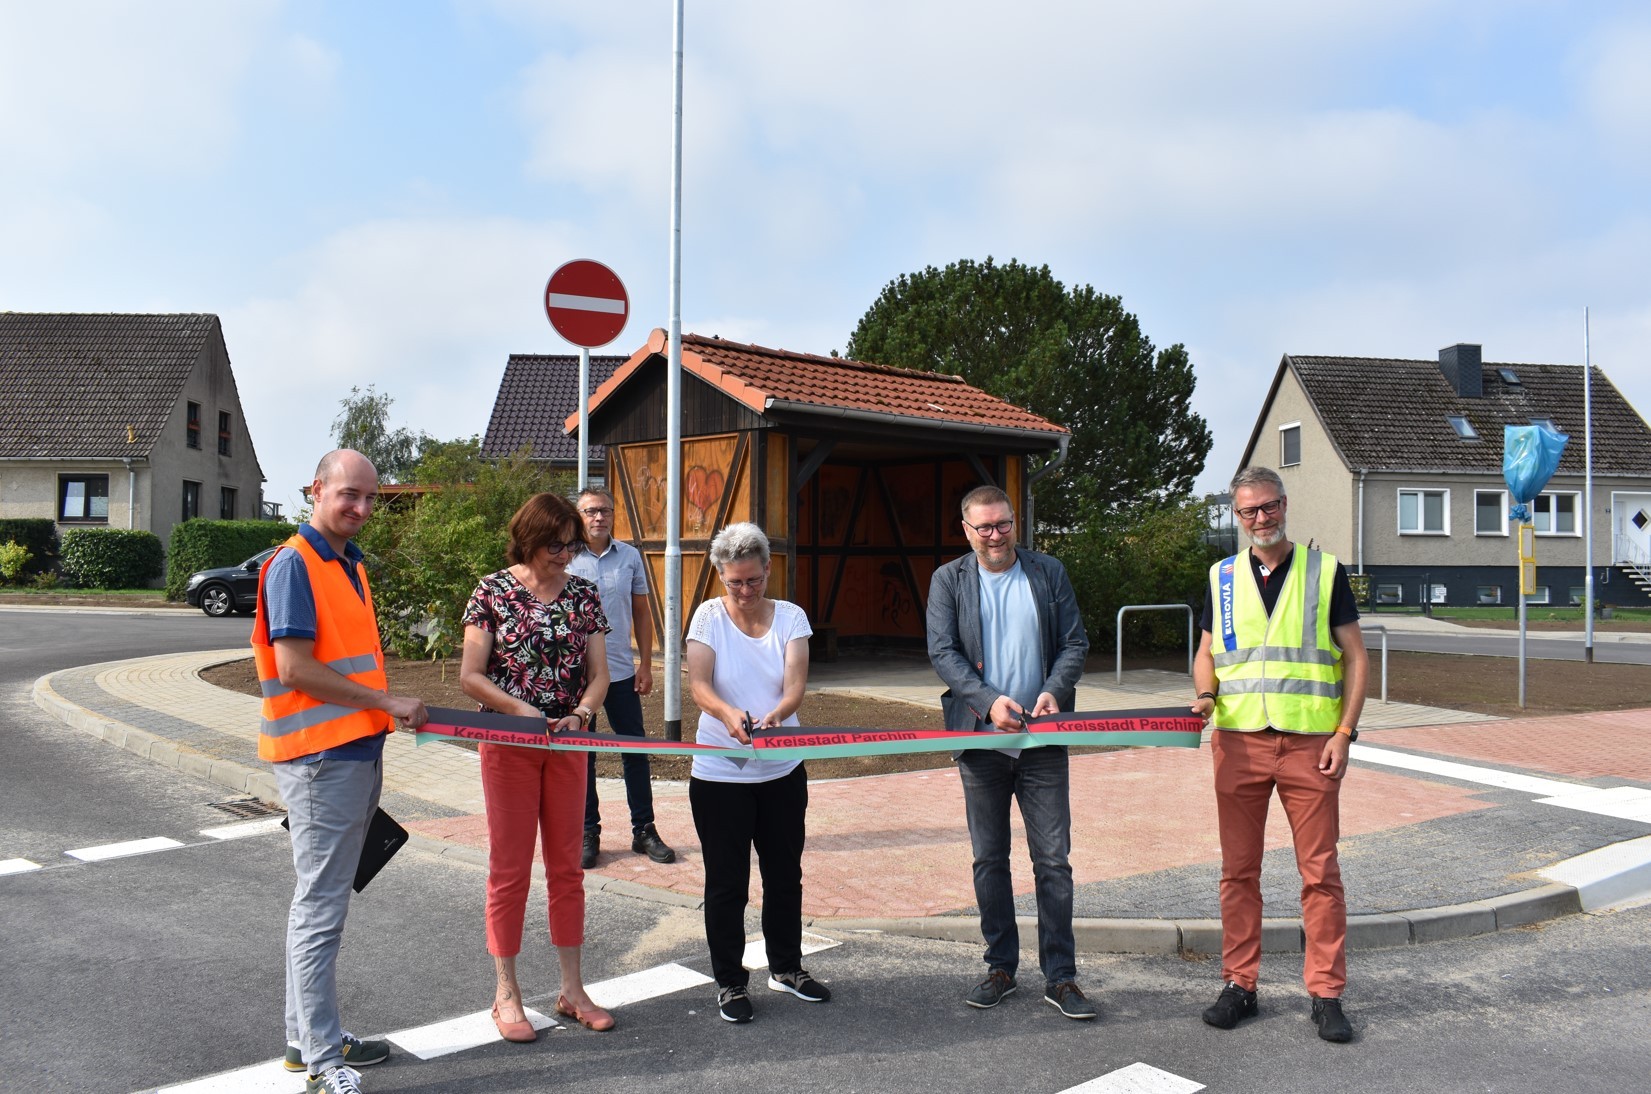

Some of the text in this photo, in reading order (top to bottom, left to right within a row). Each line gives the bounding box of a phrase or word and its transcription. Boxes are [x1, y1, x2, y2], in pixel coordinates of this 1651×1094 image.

[1222, 582, 1232, 635] EUROVIA
[1056, 718, 1201, 732] Kreisstadt Parchim
[453, 726, 544, 745] Kreisstadt
[764, 732, 917, 748] Kreisstadt Parchim
